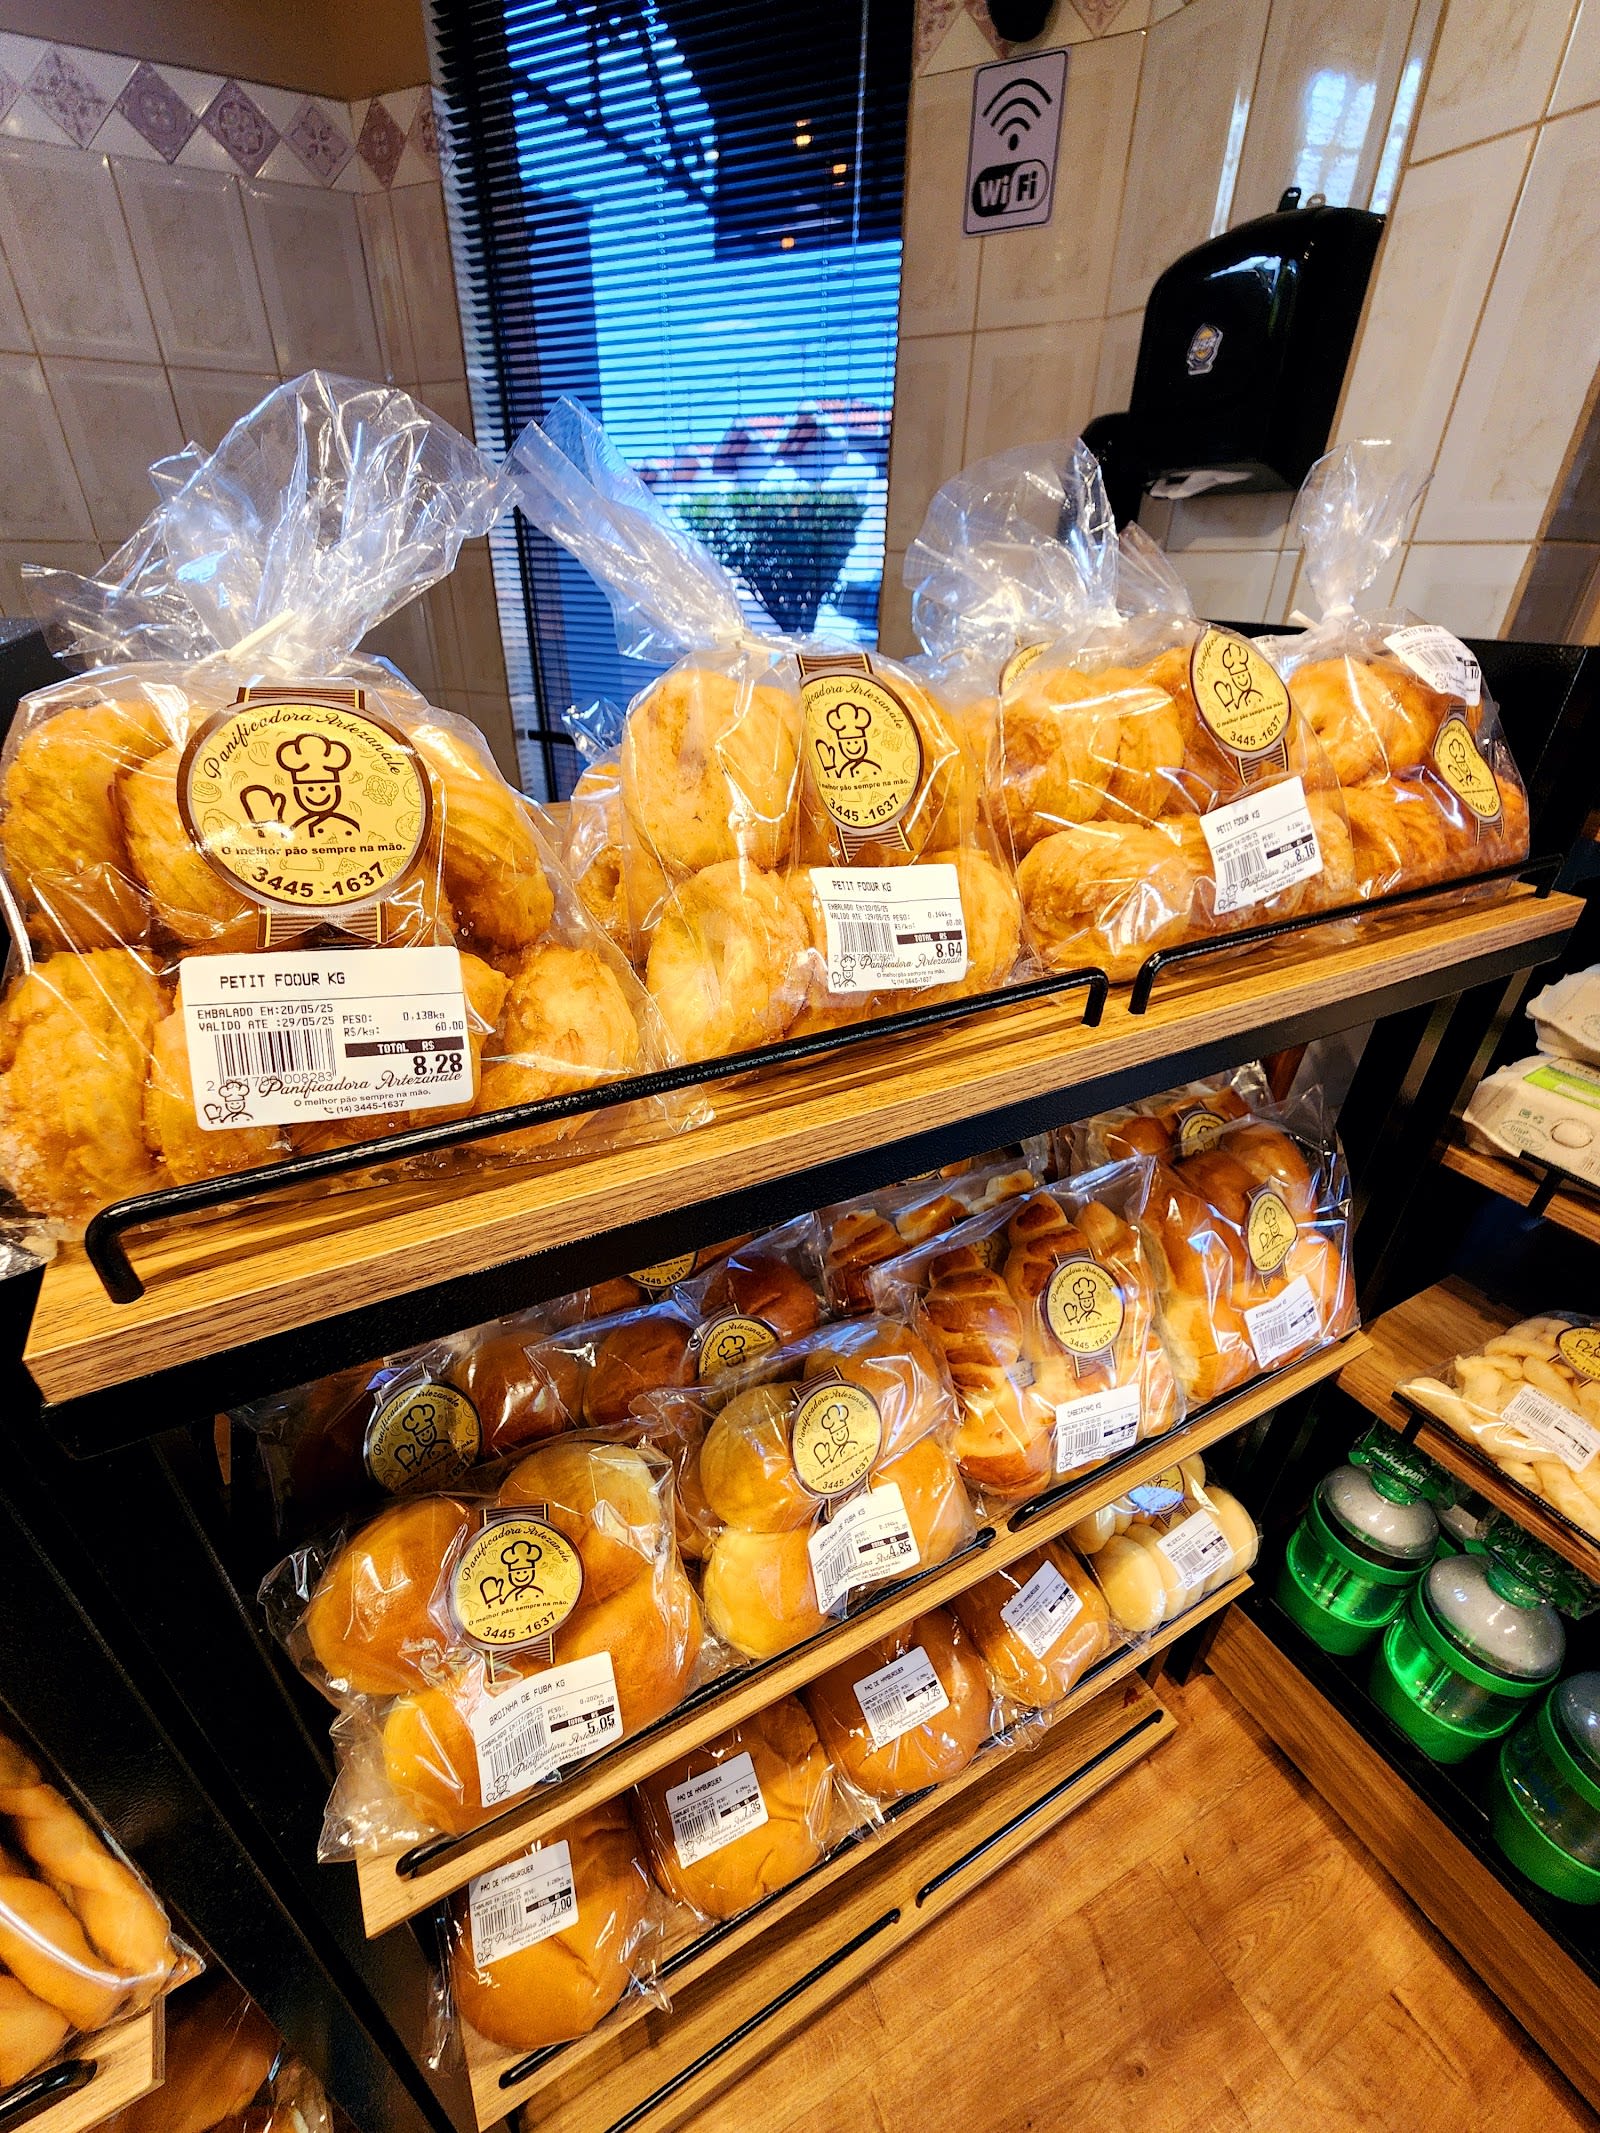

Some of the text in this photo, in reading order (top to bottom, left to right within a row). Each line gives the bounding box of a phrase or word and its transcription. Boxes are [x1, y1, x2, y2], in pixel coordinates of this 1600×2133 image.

[845, 682, 903, 729] Artezanale
[203, 709, 406, 780] Panificadora Artezanale
[1230, 731, 1256, 746] 3445
[854, 782, 881, 790] sempre
[829, 793, 900, 822] 3445 -1637
[285, 844, 308, 857] pão
[312, 844, 356, 856] sempre
[377, 842, 406, 852] mão.
[251, 862, 386, 898] 3445 -1637
[832, 880, 854, 891] PETIT
[882, 882, 892, 892] KG
[914, 932, 948, 942] TOTAL R$
[935, 942, 962, 958] 8,64
[860, 954, 962, 972] Panificadora Artezanale
[220, 972, 346, 990] PETIT FOOUR KG
[197, 1006, 253, 1020] EMBALADO
[342, 1014, 372, 1024] PESO:
[198, 1020, 241, 1032] VALIDO
[248, 1018, 268, 1029] ATE
[344, 1026, 380, 1037] R$/kg:
[378, 1040, 435, 1054] TOTAL R$
[412, 1052, 463, 1076] 8,28
[258, 1070, 462, 1098] Panificadora Artezanale
[304, 1096, 338, 1106] melhor
[340, 1094, 358, 1105] pão
[360, 1093, 394, 1103] sempre
[410, 1089, 431, 1098] mão.
[336, 1100, 405, 1114] (14) 3445-1637
[1069, 1338, 1089, 1349] 3445
[796, 1395, 829, 1449] Panificadora
[822, 1456, 869, 1490] 3445 -1637
[462, 1526, 569, 1581] Panificadora Artezanale
[476, 1612, 500, 1624] melhor
[501, 1607, 514, 1616] pão
[515, 1602, 541, 1612] sempre
[483, 1611, 556, 1639] 3445 -1637
[489, 1679, 566, 1726] BROINHA DE FUBA KG
[587, 1714, 615, 1735] 5,05
[687, 1790, 693, 1798] DE
[480, 1864, 534, 1892] PAO DE HAMBURGUER
[552, 1896, 572, 1916] 7,00
